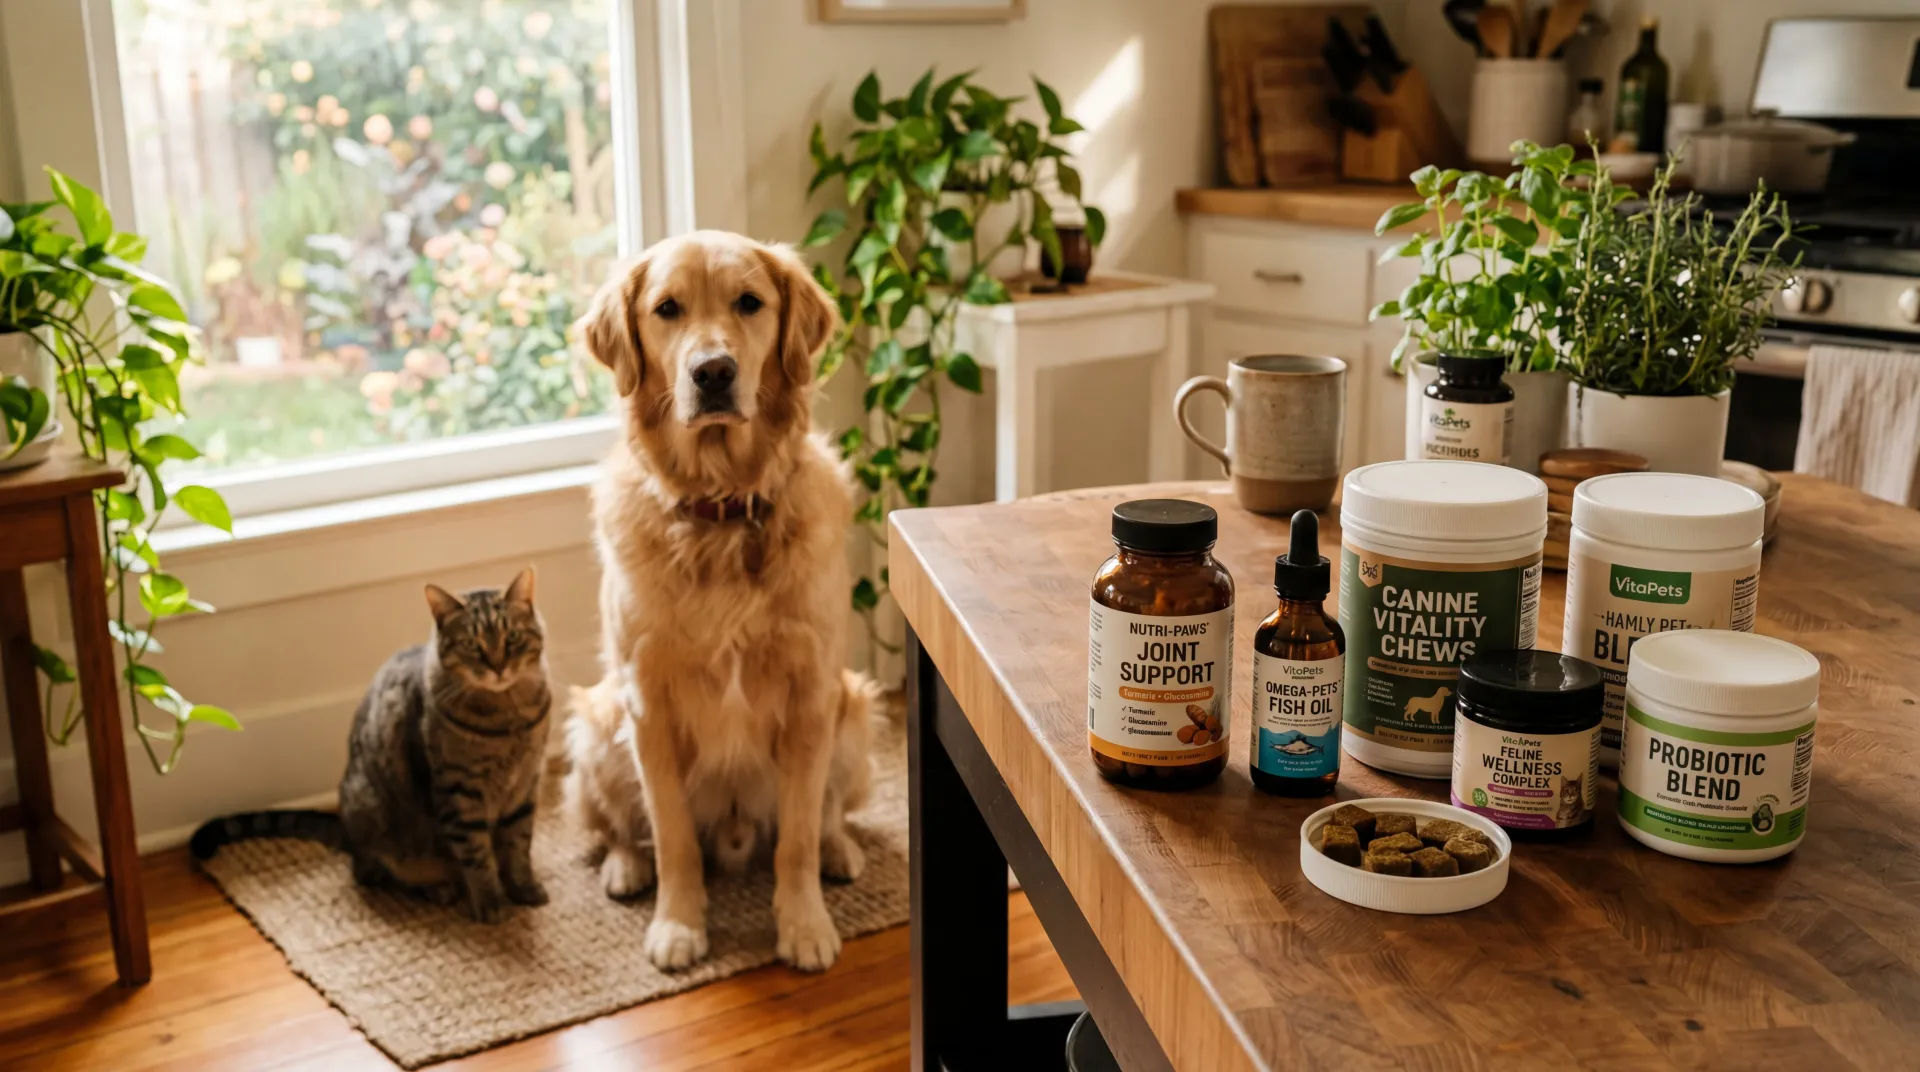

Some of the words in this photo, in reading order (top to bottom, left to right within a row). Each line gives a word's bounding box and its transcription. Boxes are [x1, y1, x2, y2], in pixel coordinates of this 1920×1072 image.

[1615, 576, 1683, 597] VitaPets
[1382, 585, 1479, 614] CANINE
[1373, 607, 1487, 638] VITALITY
[1605, 611, 1655, 633] HAMLY
[1137, 641, 1199, 662] JOINT
[1381, 634, 1476, 663] CHEWS
[1120, 661, 1215, 685] SUPPORT
[1266, 681, 1338, 698] OMEGA-PETS
[1269, 696, 1305, 716] FISH
[1310, 698, 1333, 716] OIL
[1482, 753, 1562, 776] WELLNESS
[1500, 746, 1543, 761] FELINE
[1649, 737, 1766, 776] PROBIOTIC
[1492, 772, 1551, 789] COMPLEX
[1666, 769, 1741, 801] BLEND
